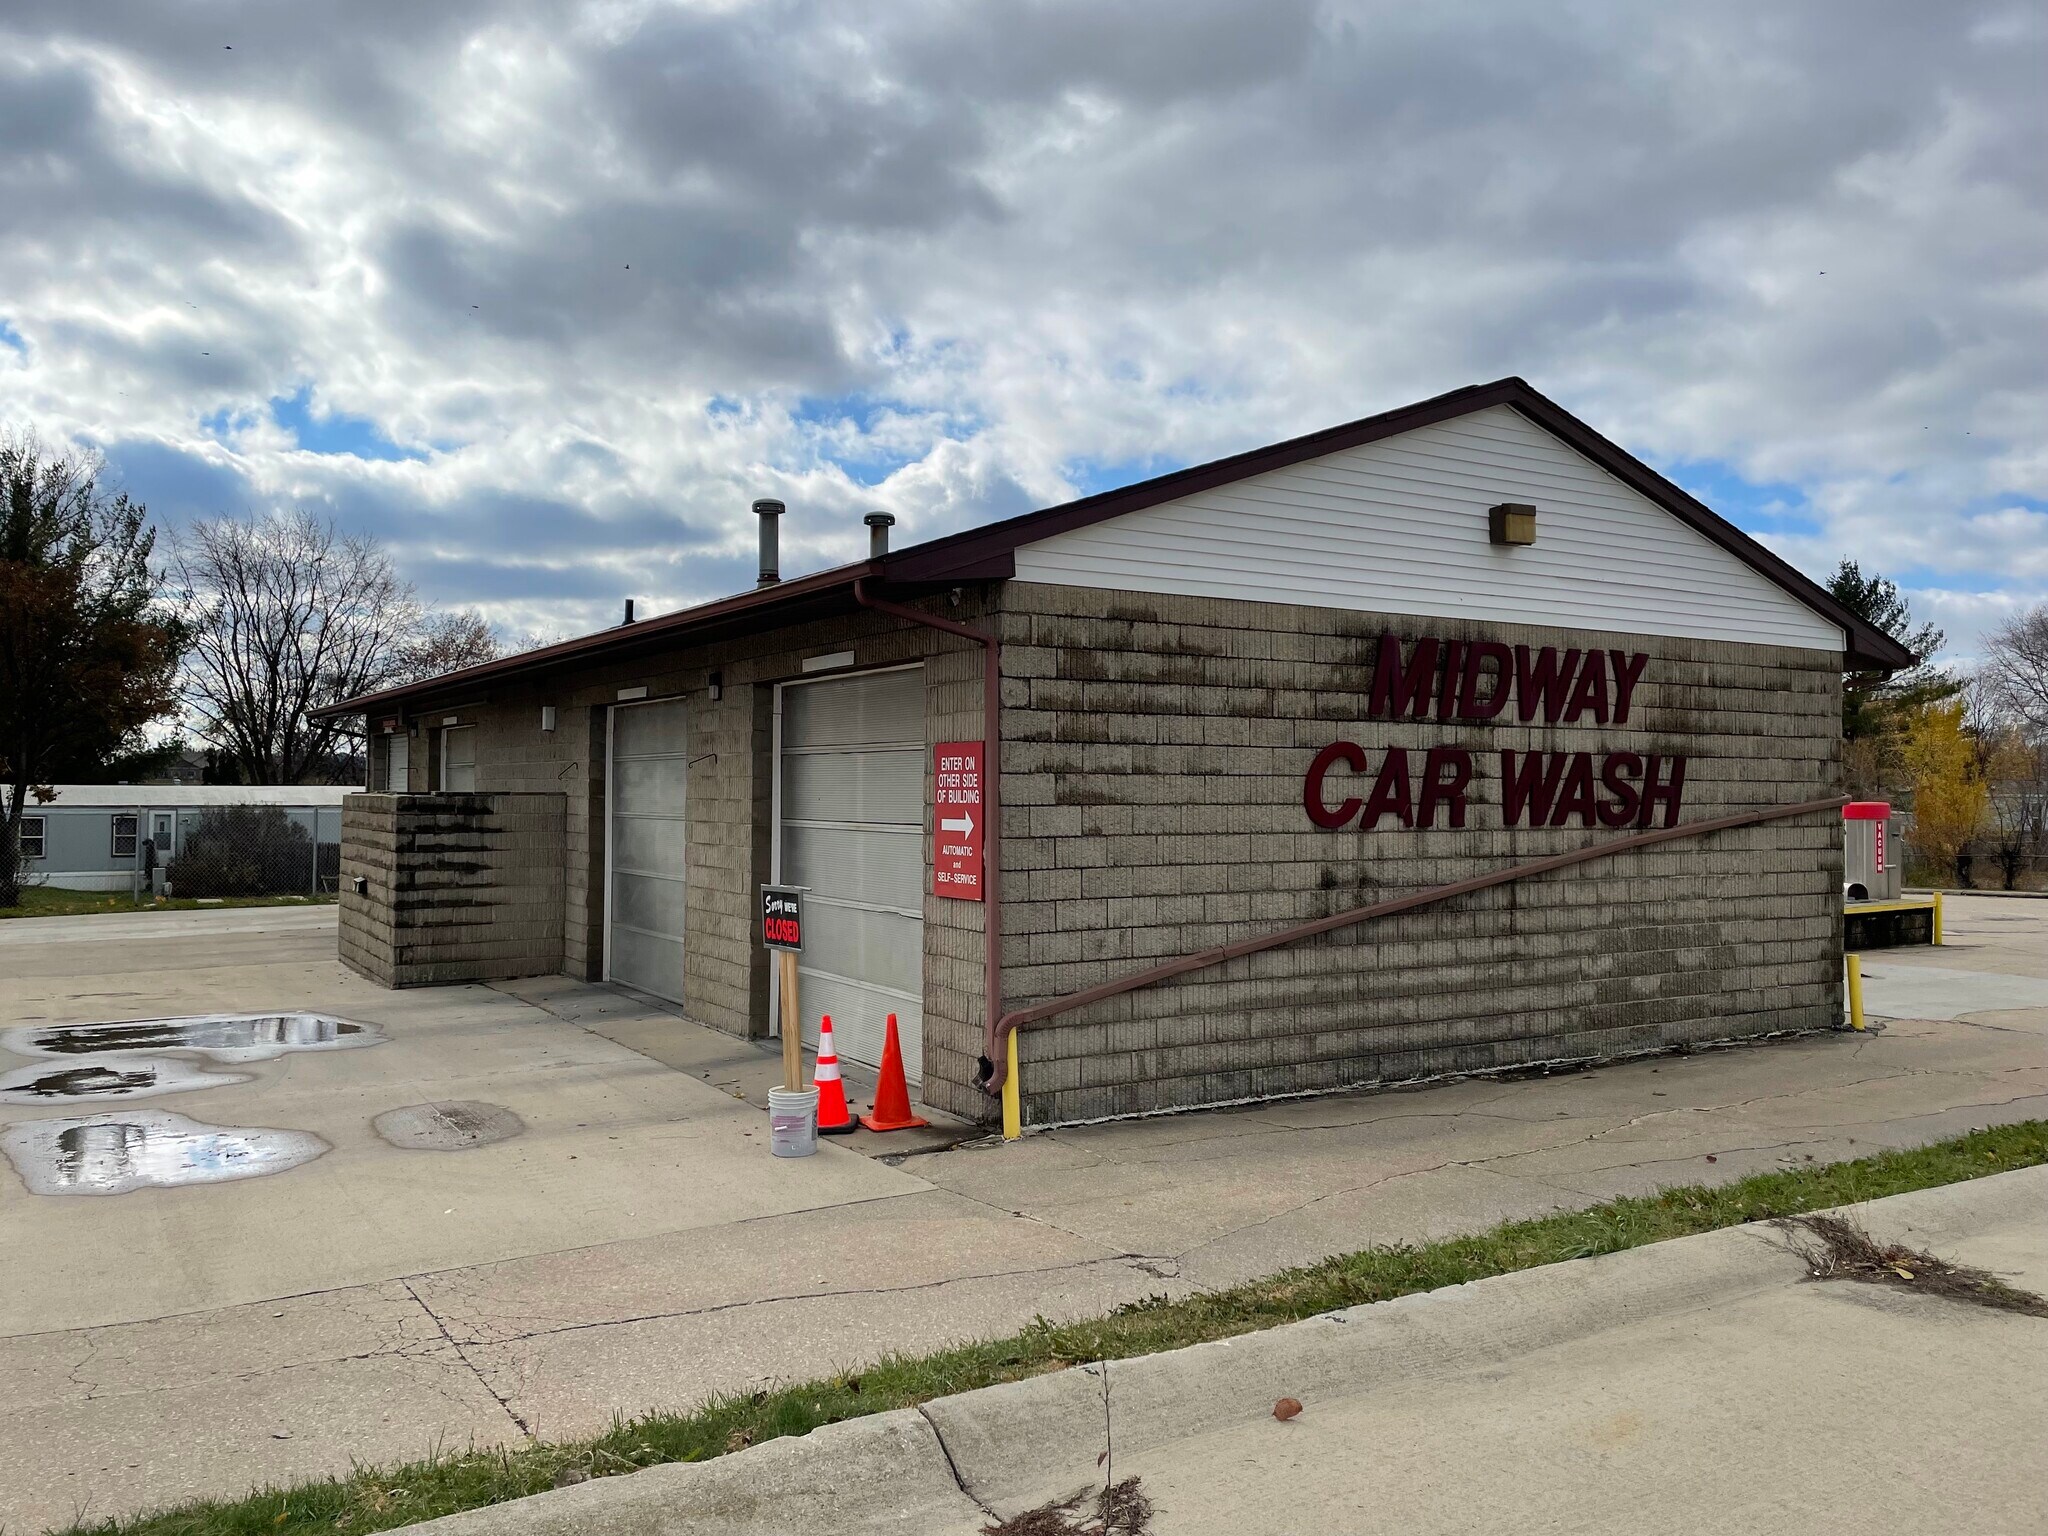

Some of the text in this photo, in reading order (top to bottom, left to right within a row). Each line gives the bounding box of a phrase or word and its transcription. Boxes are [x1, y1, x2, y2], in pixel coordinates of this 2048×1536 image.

[1368, 634, 1650, 724] MIDWAY
[941, 756, 975, 771] ENTER ON
[938, 773, 978, 788] OTHER SIDE
[1304, 741, 1687, 829] CAR WASH
[937, 789, 980, 804] OF BUILDING
[942, 844, 973, 857] AUTOMATIC
[952, 860, 962, 869] and
[937, 871, 977, 885] SELF-SERVICE
[765, 894, 783, 915] Sorry
[765, 917, 799, 943] CLOSED
